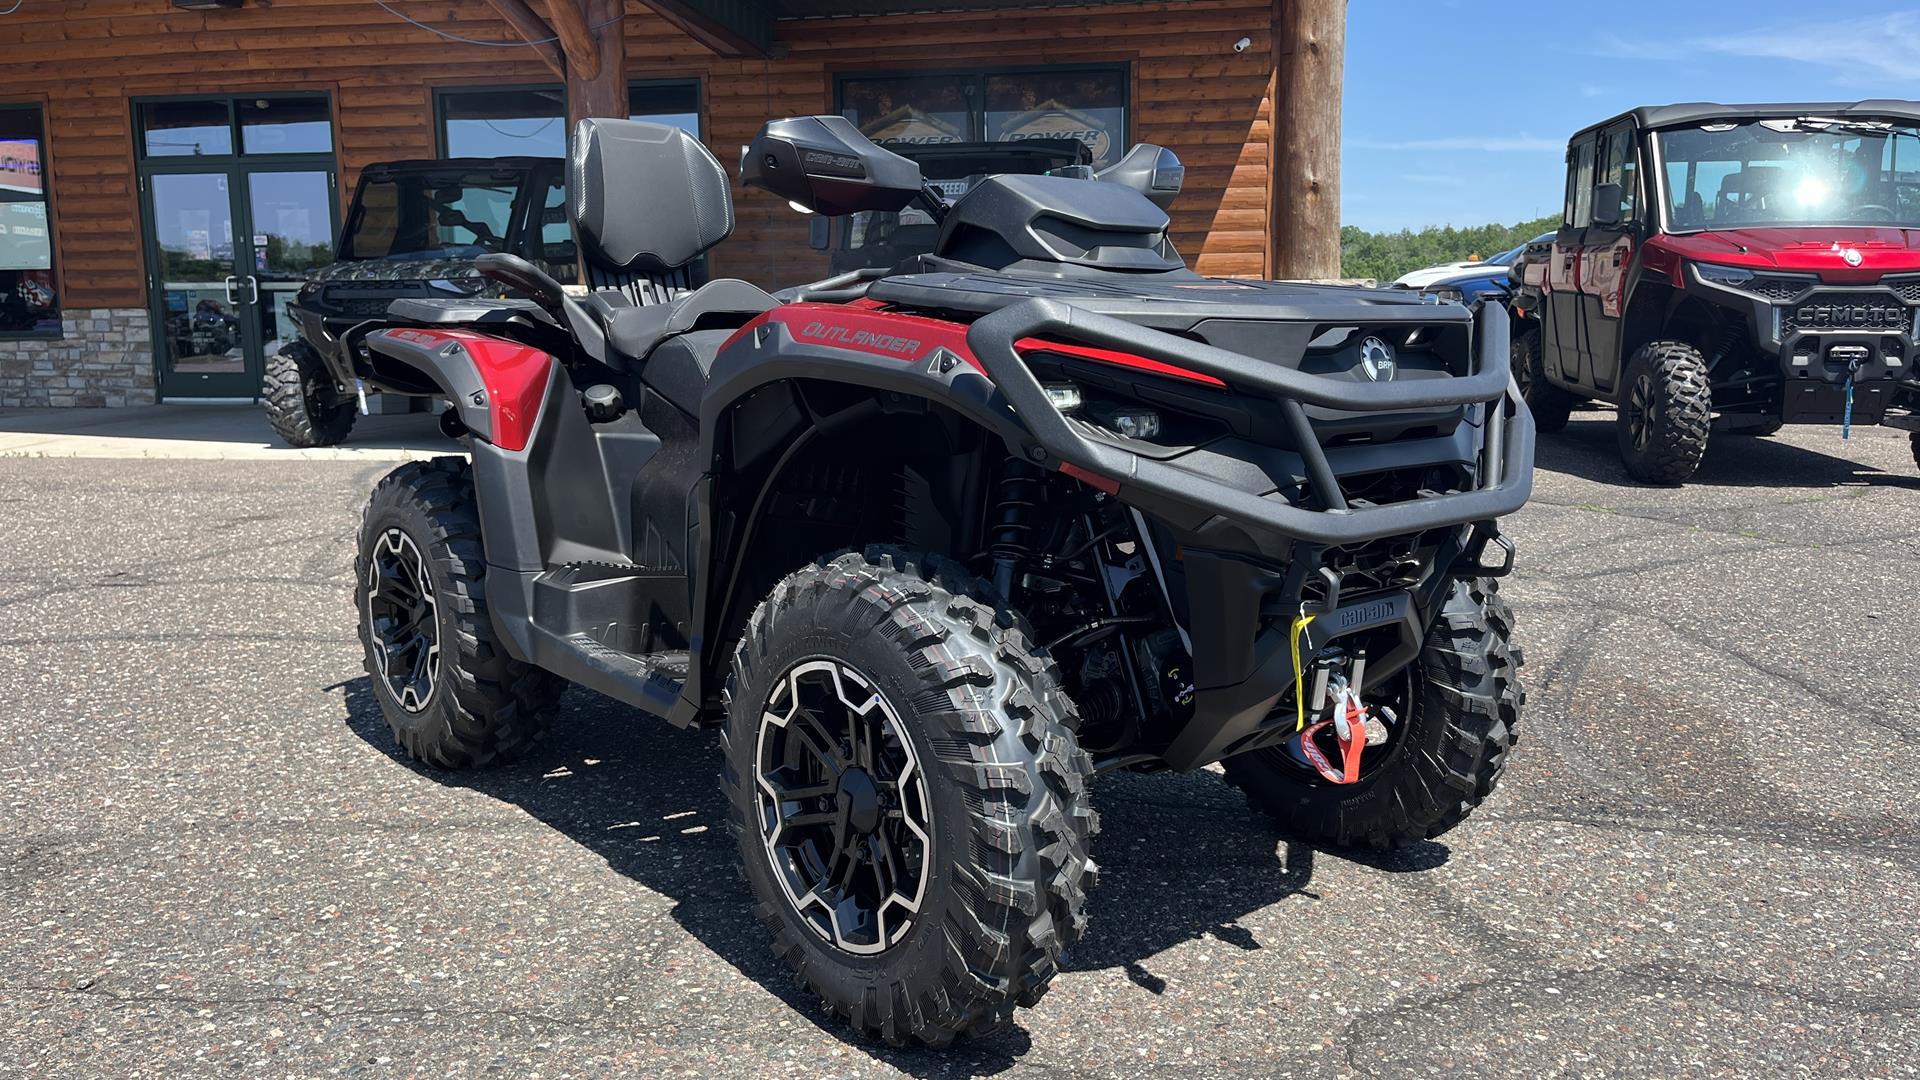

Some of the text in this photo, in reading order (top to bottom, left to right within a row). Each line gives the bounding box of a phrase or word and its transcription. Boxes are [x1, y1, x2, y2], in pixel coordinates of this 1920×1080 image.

[1797, 307, 1901, 322] CFMOTO
[800, 321, 921, 354] OUTLANDER
[1377, 360, 1392, 370] BRP
[1340, 601, 1395, 628] can-am
